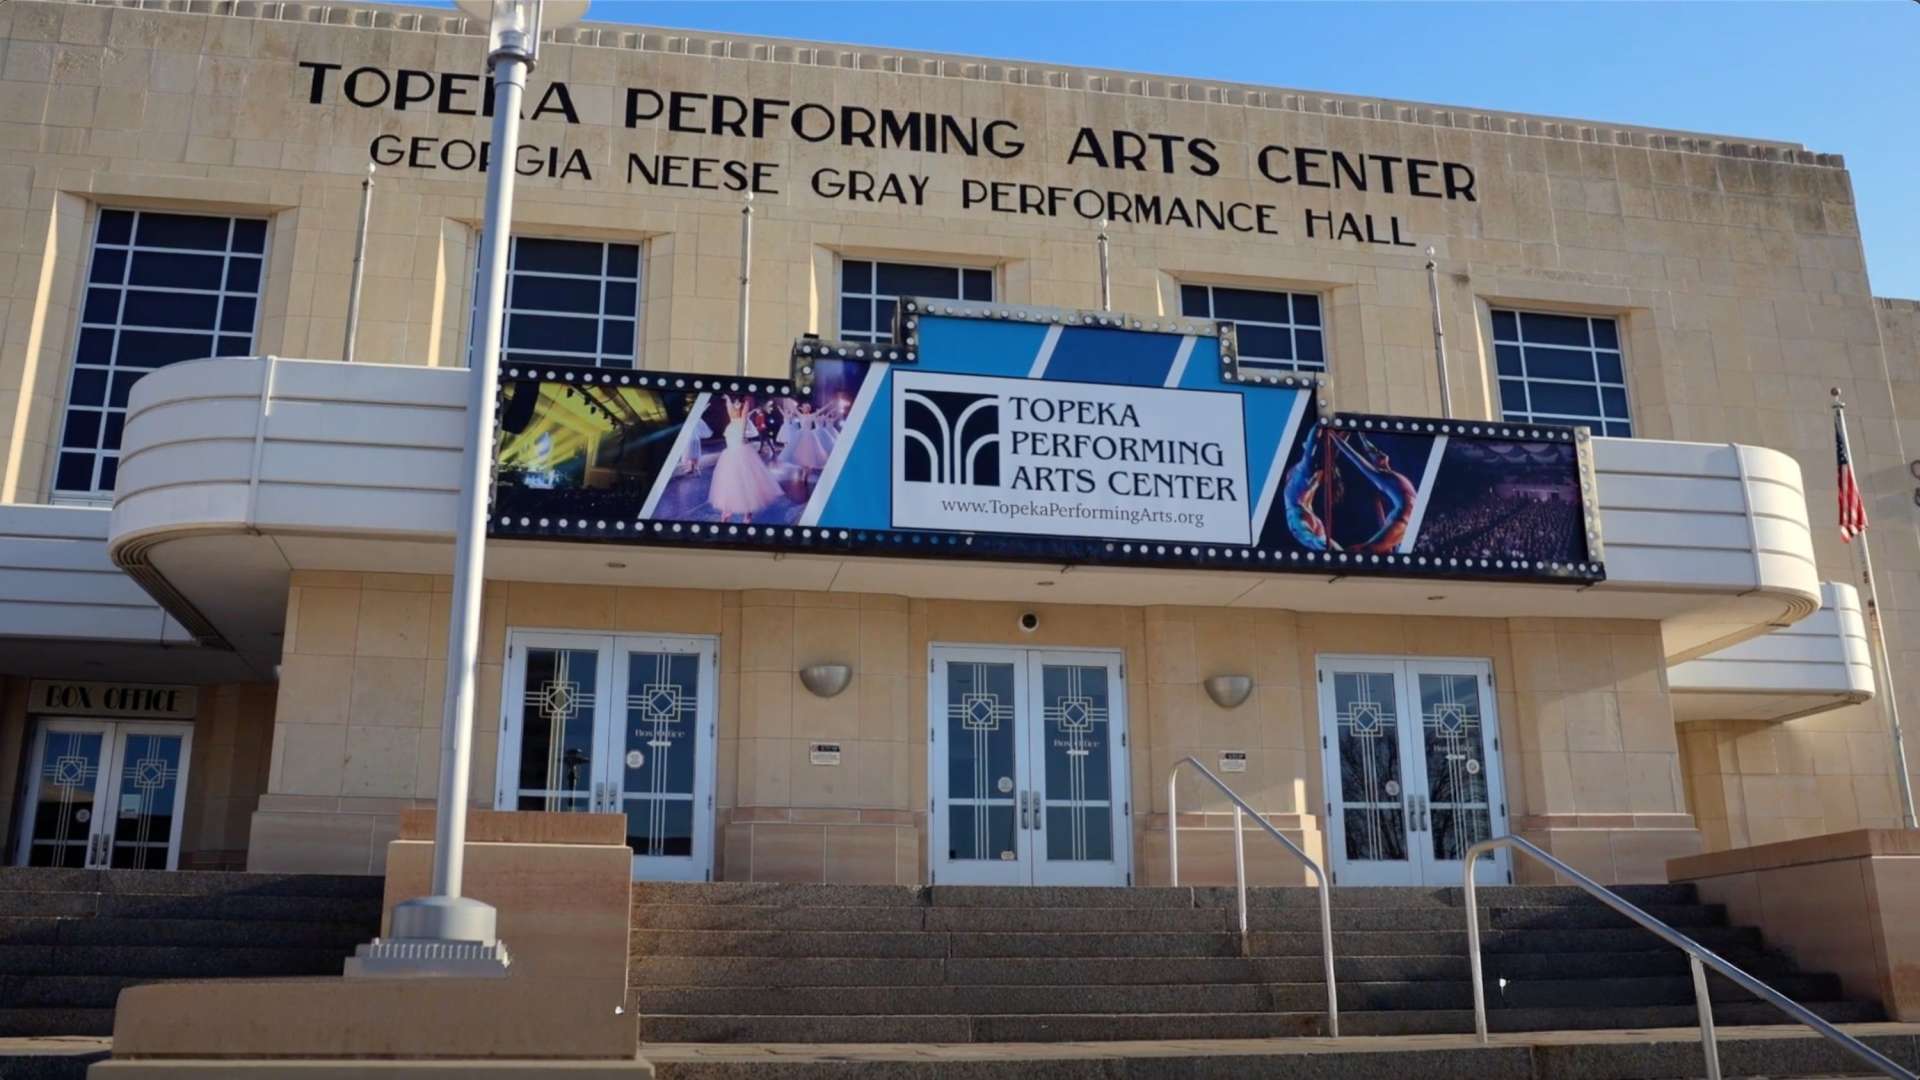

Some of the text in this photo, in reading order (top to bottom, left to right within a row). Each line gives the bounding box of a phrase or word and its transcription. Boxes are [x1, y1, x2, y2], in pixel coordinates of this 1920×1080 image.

[624, 87, 1025, 159] PERFORMING
[1067, 127, 1220, 177] ARTS
[1257, 145, 1477, 202] CENTER
[627, 152, 779, 195] NEESE
[811, 167, 929, 206] GRAY
[962, 179, 1279, 235] PERFORMANCE
[1305, 208, 1417, 247] HALL
[1009, 396, 1141, 428] TOPEKA
[1010, 431, 1225, 467] PERFORMING
[1011, 465, 1238, 502] ARTS CENTER
[941, 499, 1205, 528] www.TopekaPerformingArts.org
[45, 685, 181, 712] BOX OFFICE
